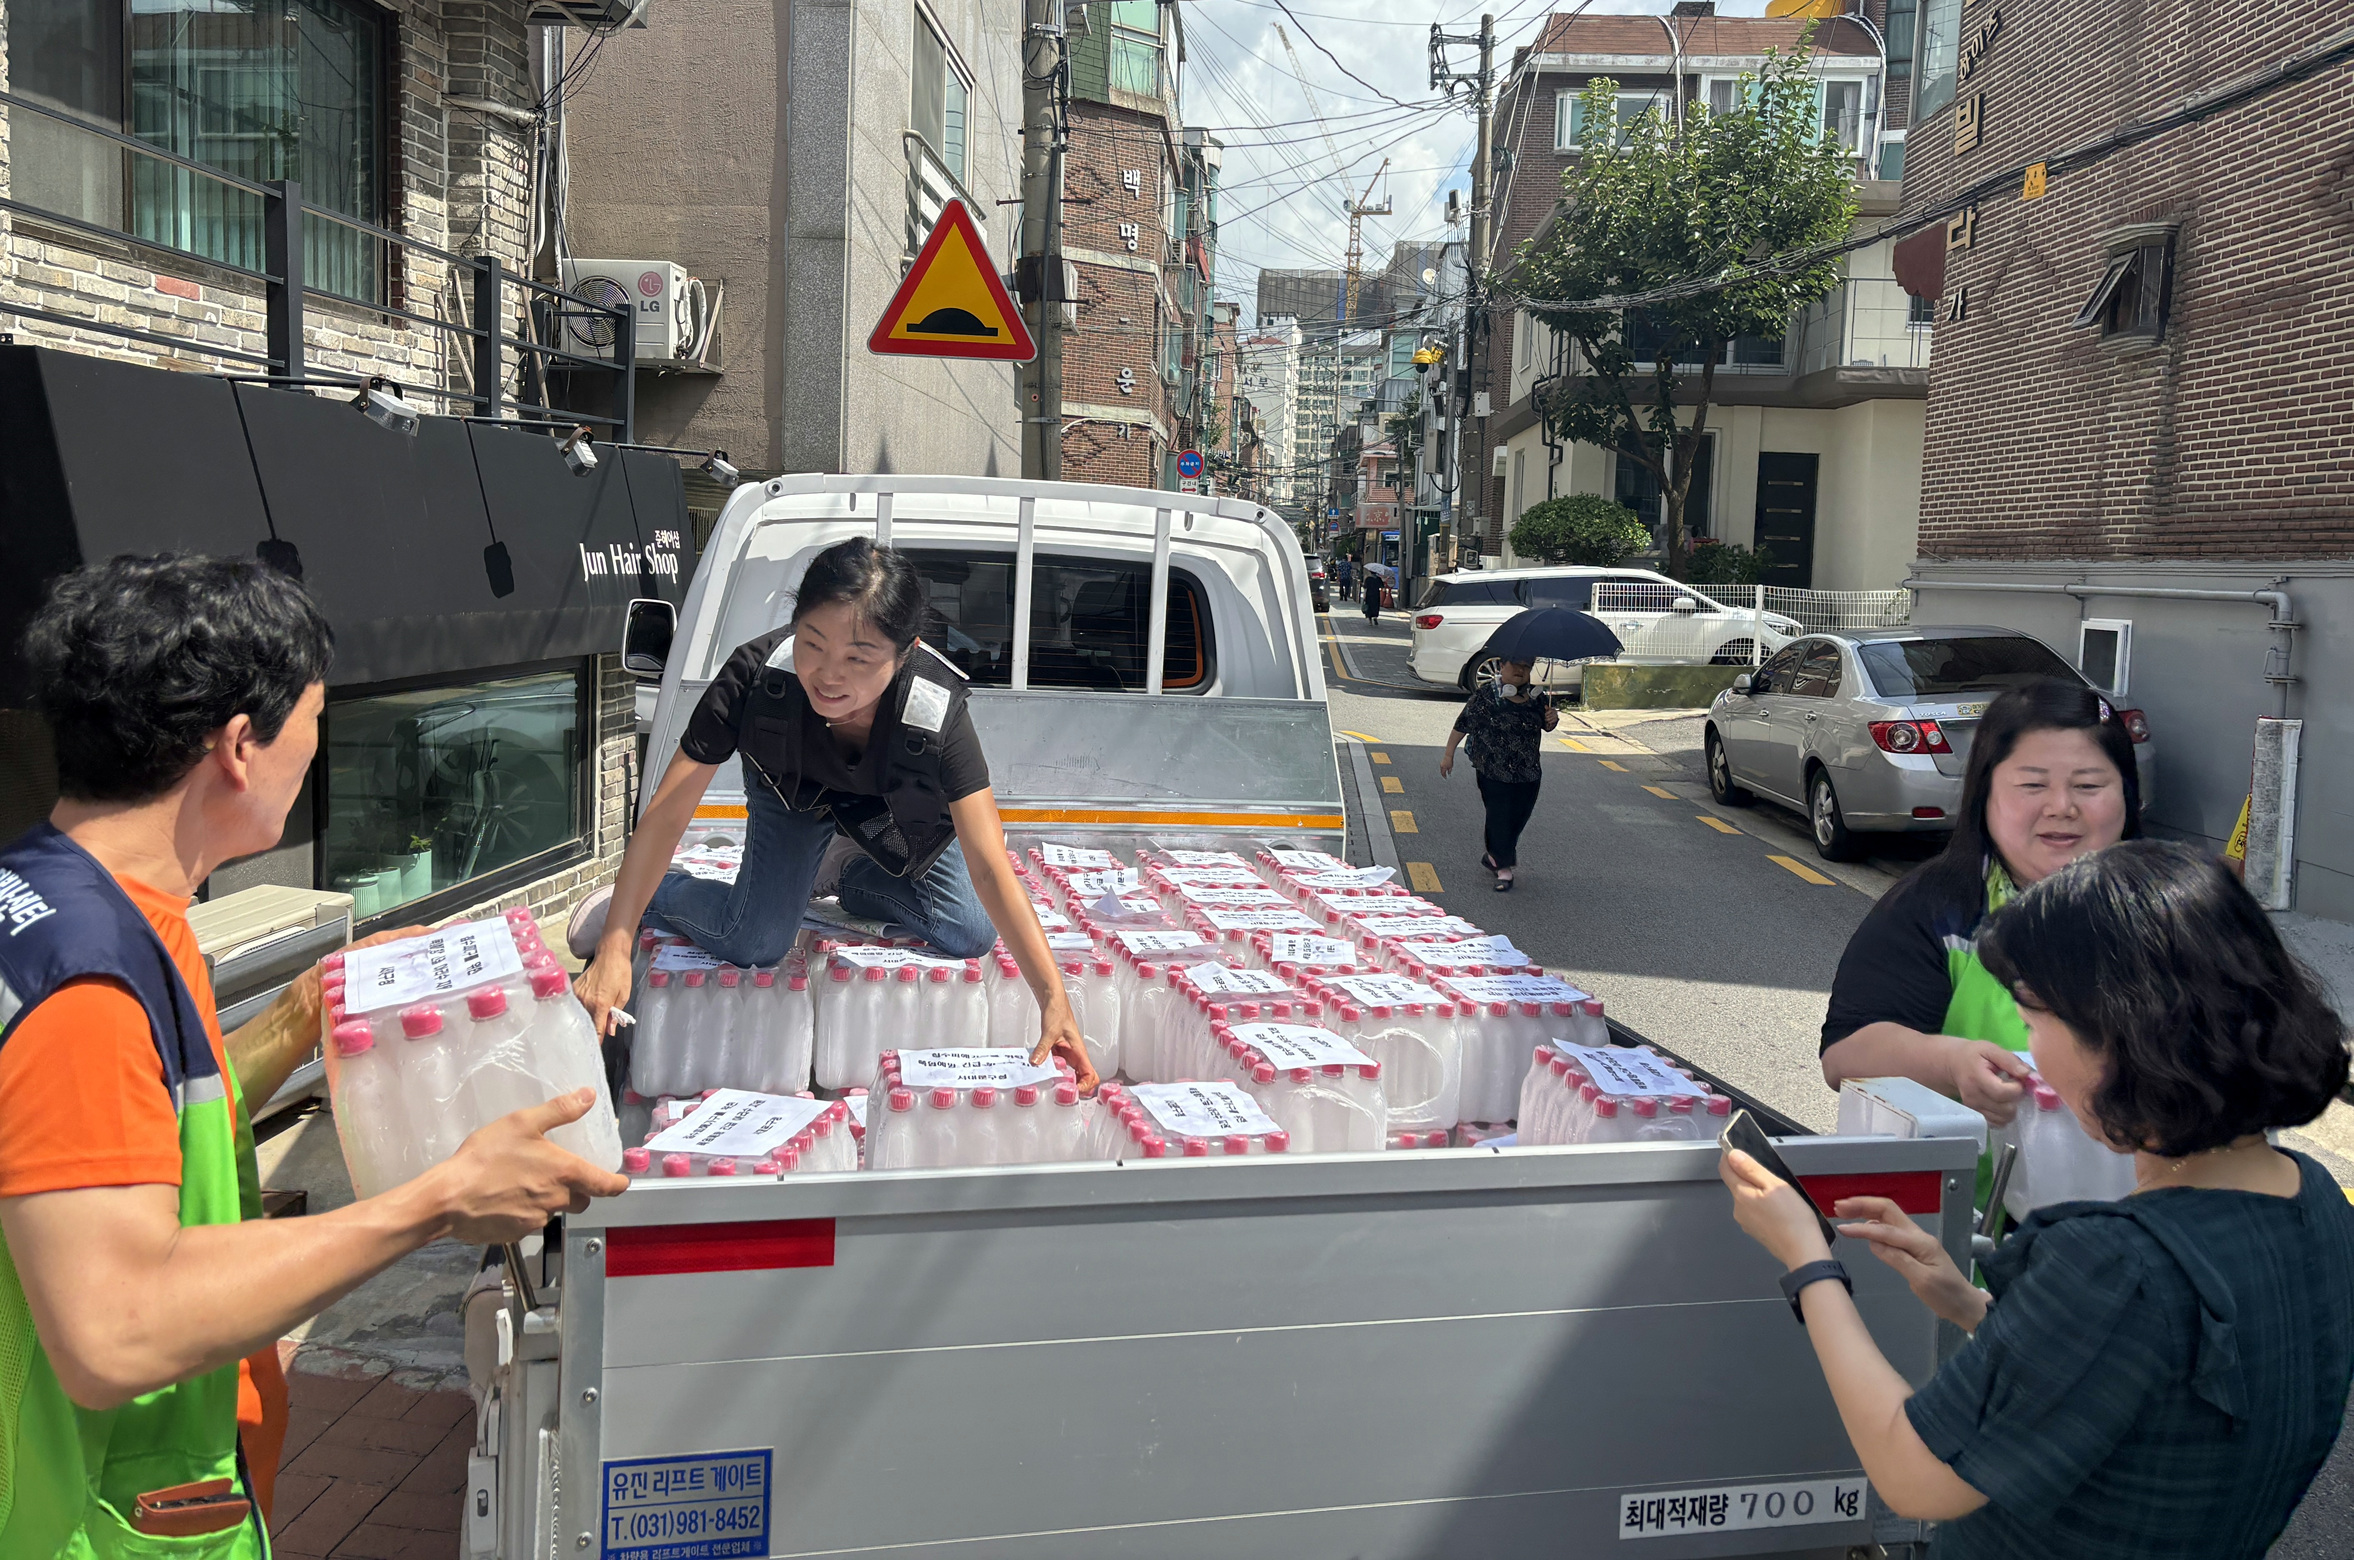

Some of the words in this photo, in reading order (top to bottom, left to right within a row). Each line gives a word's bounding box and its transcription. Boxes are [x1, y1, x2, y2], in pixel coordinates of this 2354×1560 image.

[640, 300, 660, 312] LG
[654, 529, 681, 549] 준헤어샵
[579, 542, 608, 582] Jun
[609, 541, 642, 575] Hair
[645, 542, 679, 584] Shop
[612, 1471, 648, 1501] 유진
[653, 1467, 705, 1497] 리프트
[710, 1463, 761, 1492] 게이트
[1625, 1493, 1729, 1532] 최대적재량
[1740, 1490, 1815, 1520] 700
[1834, 1486, 1860, 1517] kg
